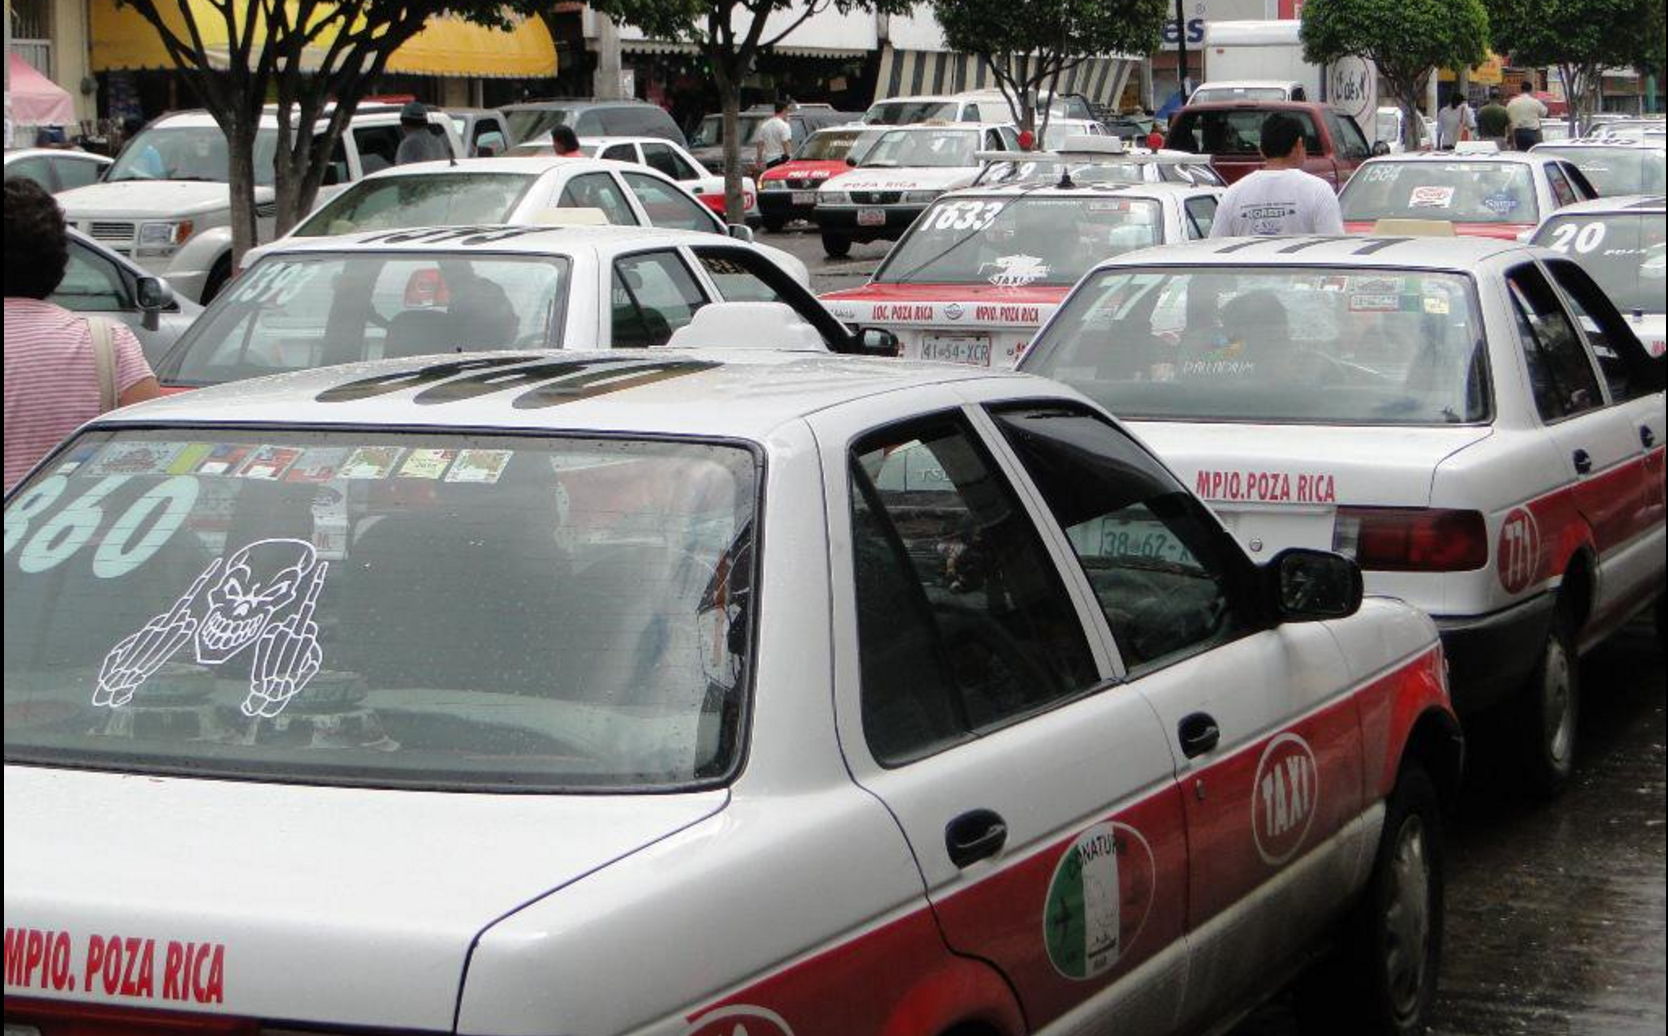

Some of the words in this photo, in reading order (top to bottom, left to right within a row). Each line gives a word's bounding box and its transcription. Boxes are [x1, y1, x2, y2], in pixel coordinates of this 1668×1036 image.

[920, 202, 1004, 231] 1633
[1547, 221, 1606, 254] 20
[891, 306, 913, 320] POZA
[914, 306, 933, 321] RICA
[1000, 306, 1021, 322] POZA
[1022, 308, 1039, 322] RICA
[1297, 474, 1336, 502] RICA
[1262, 755, 1309, 836] TAXI
[84, 934, 156, 998] POZA
[162, 940, 226, 1004] RICA
